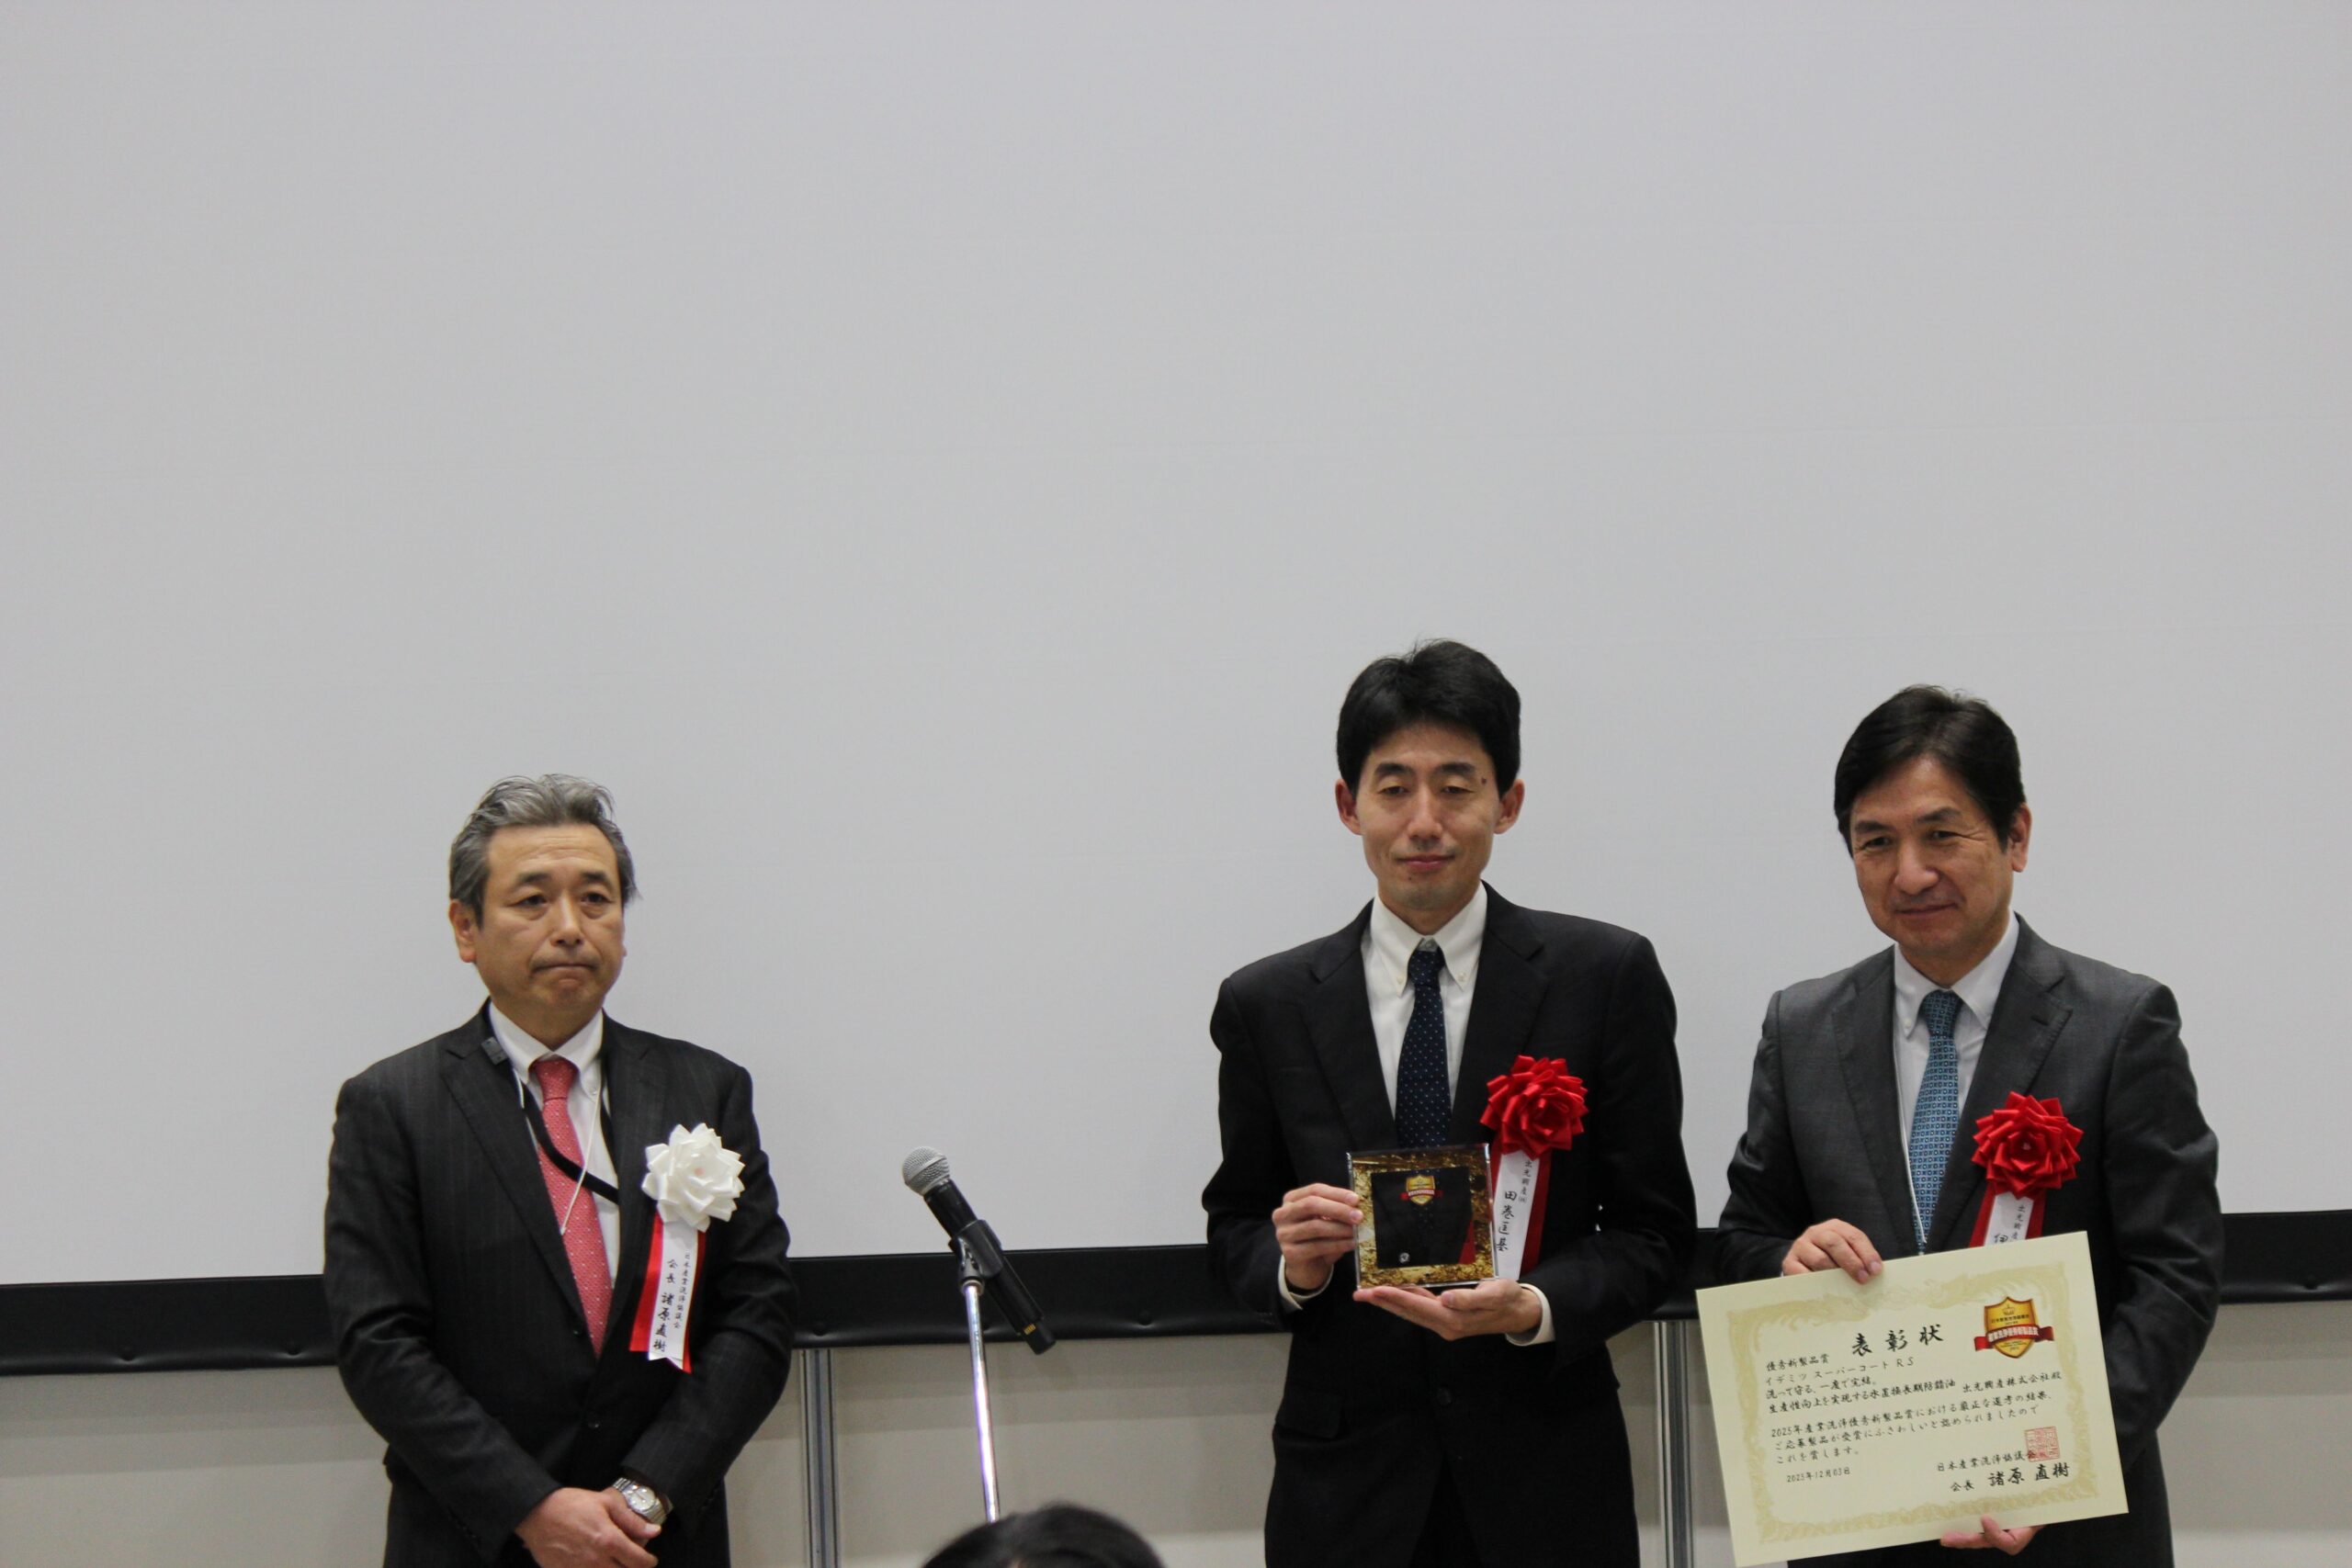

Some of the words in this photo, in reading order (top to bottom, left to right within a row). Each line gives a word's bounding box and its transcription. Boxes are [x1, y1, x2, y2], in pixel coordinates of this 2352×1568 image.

[666, 1258, 678, 1284] 会長
[1852, 1324, 1944, 1357] 表彰状
[1766, 1353, 1829, 1371] 優秀新製品賞
[1766, 1373, 1807, 1386] イデミツ
[1815, 1361, 1889, 1378] スーパーコート
[1777, 1446, 1859, 1464] これを賞します。
[1937, 1450, 2037, 1472] 日本産業洗浄協議会
[1951, 1480, 1974, 1492] 会長
[1987, 1467, 2025, 1486] 諸原
[2035, 1462, 2070, 1481] 直樹
